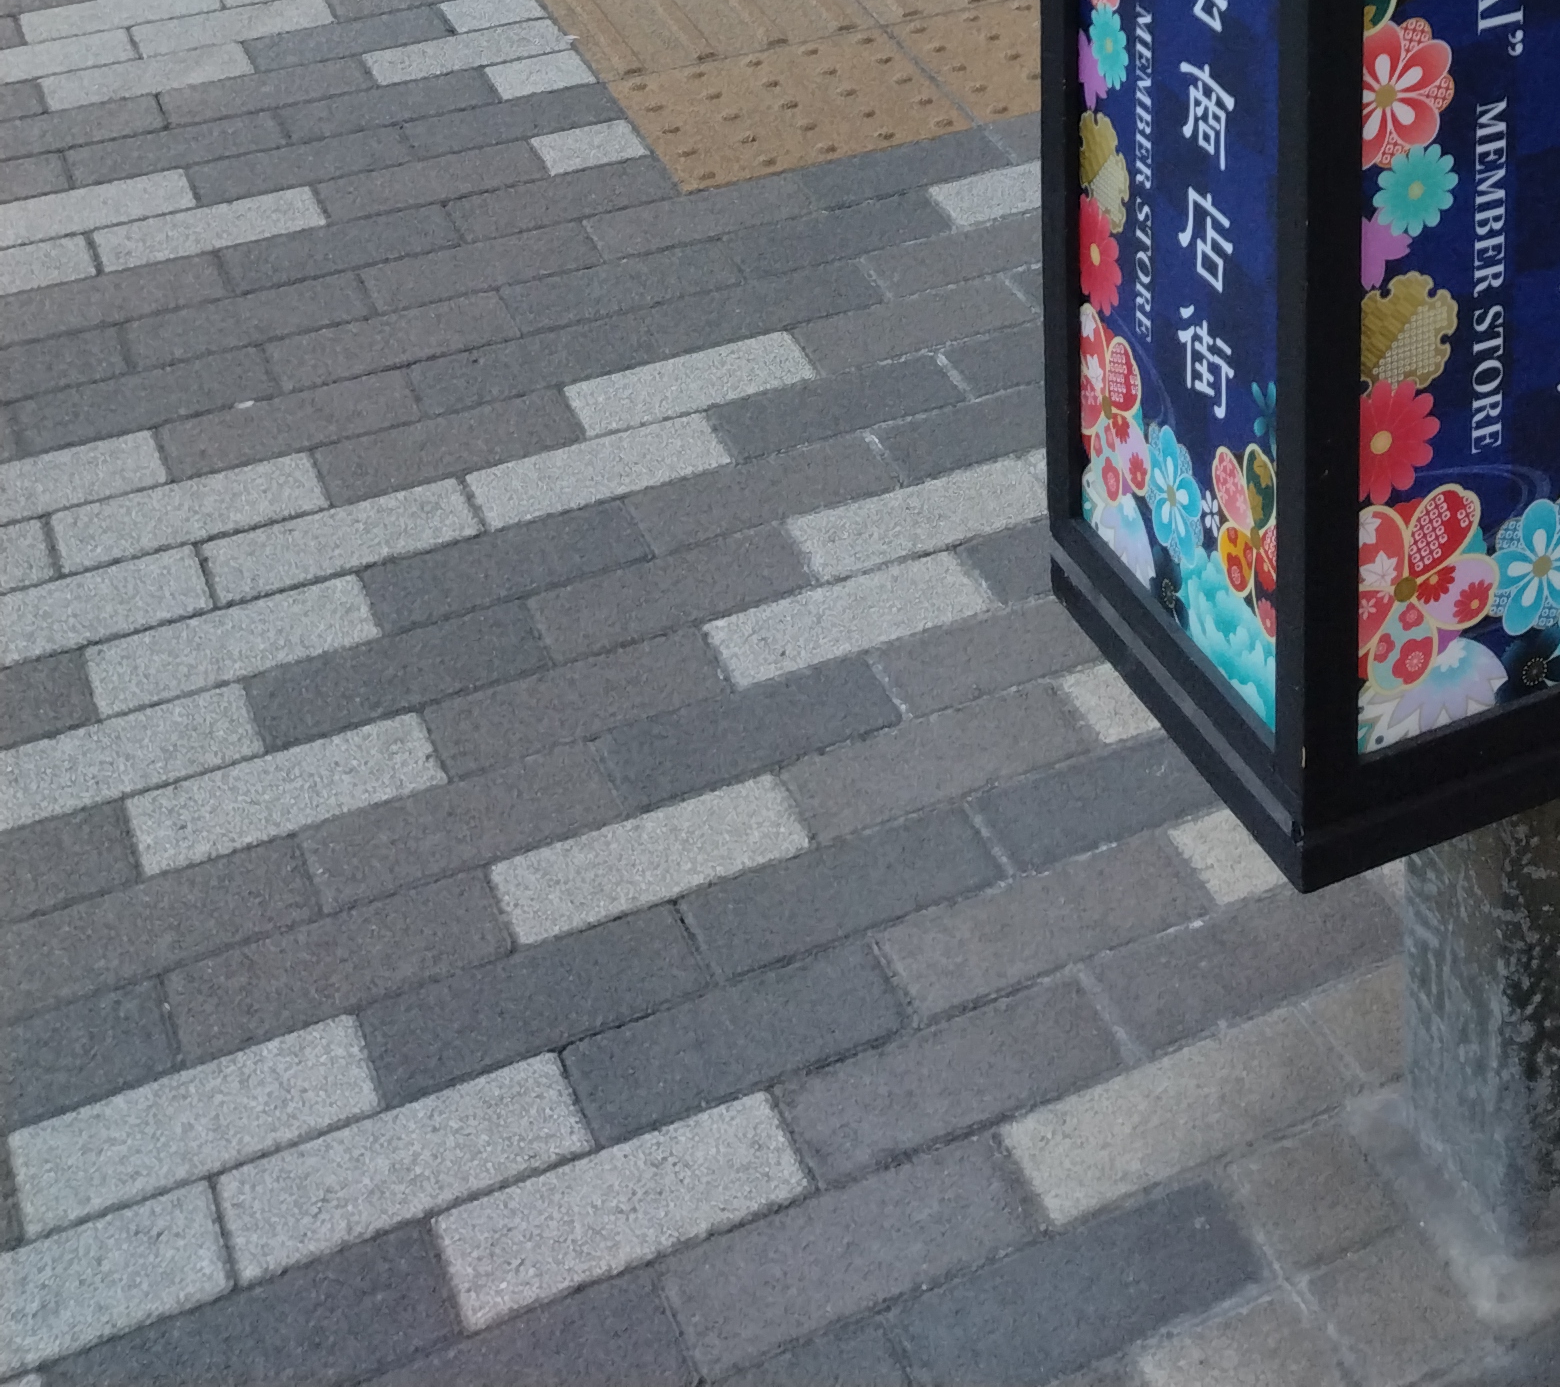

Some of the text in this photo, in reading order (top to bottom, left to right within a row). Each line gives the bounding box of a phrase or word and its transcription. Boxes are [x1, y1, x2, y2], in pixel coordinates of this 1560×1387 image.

[1135, 3, 1153, 190] MEMBER
[1135, 197, 1152, 343] STORE
[1473, 98, 1508, 298] MEMBER
[1471, 305, 1505, 455] STORE
